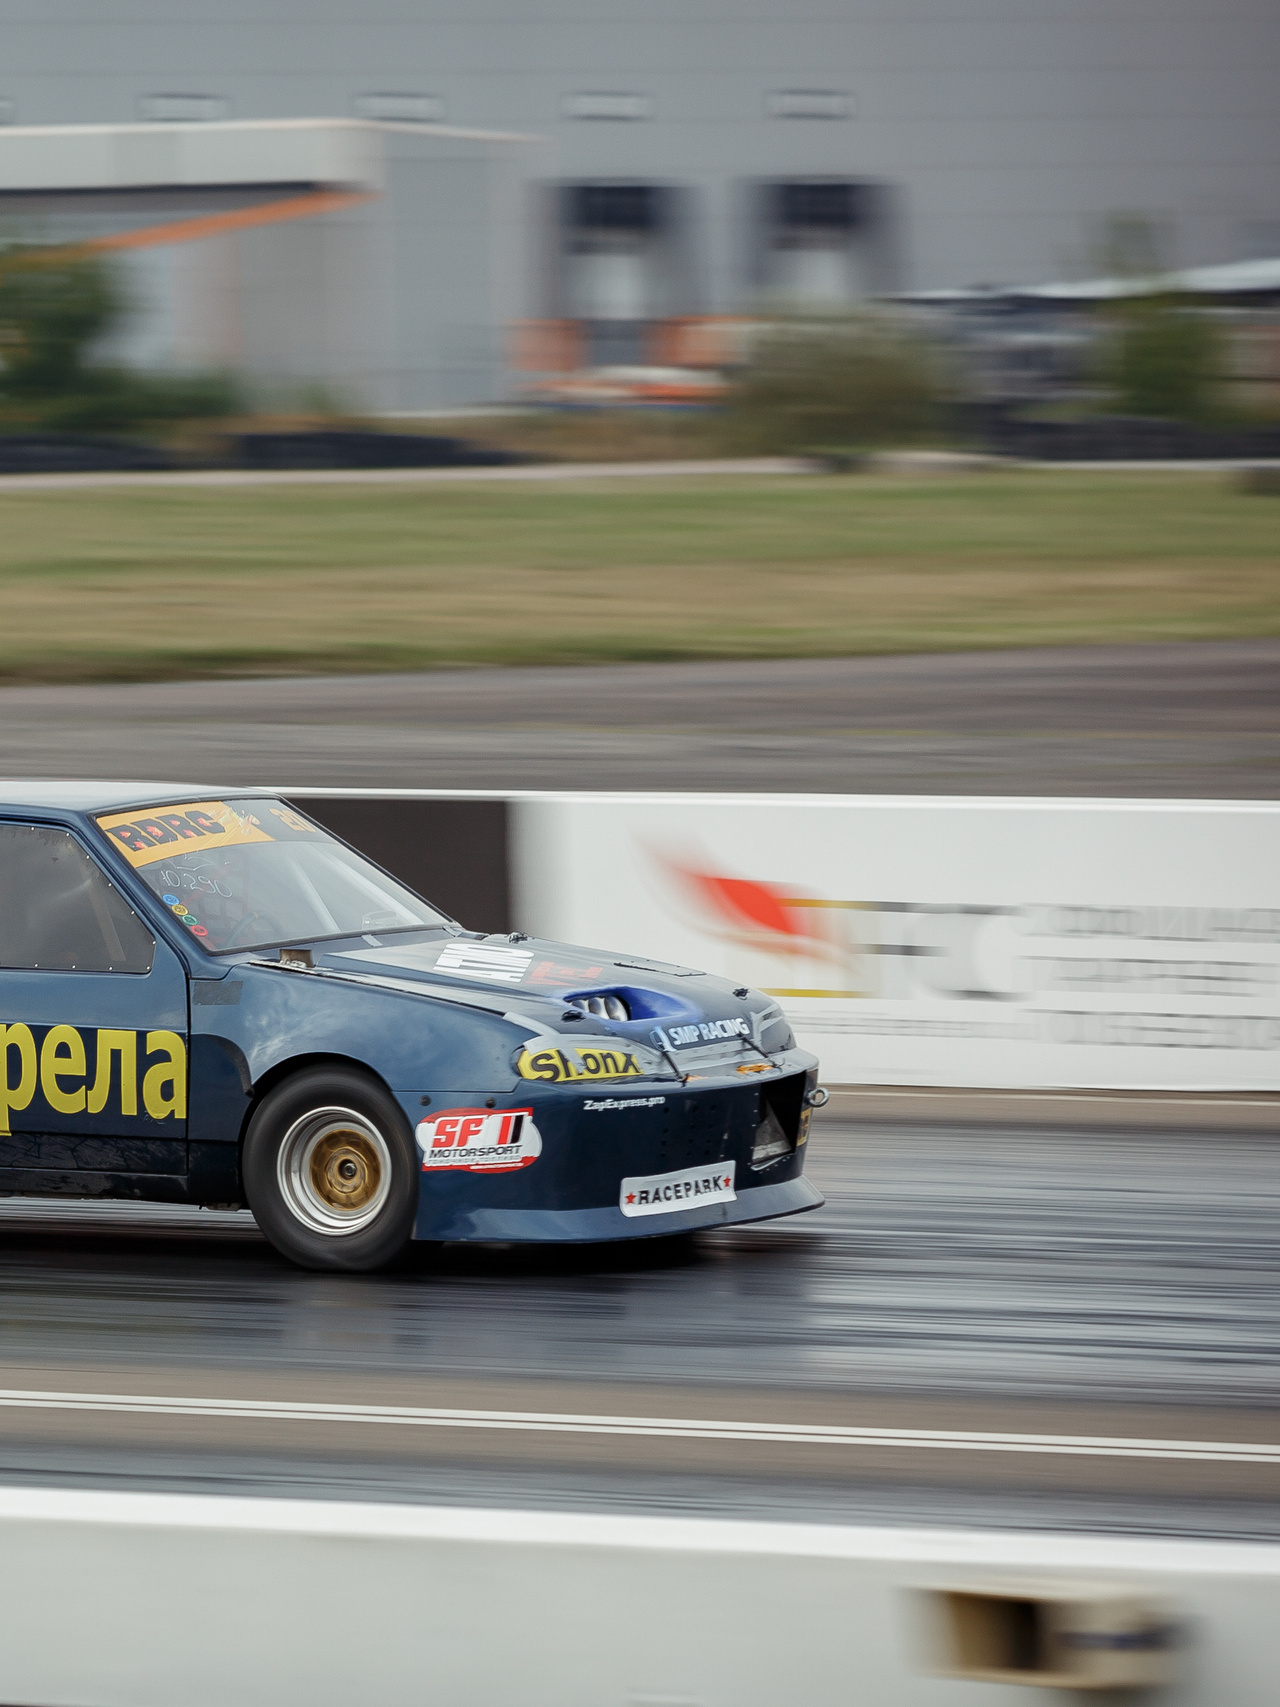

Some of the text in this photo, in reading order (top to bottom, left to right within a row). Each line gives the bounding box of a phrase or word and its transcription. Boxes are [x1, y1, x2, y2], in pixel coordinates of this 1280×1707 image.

[104, 810, 226, 852] RDRC
[668, 1017, 751, 1046] SMP RACING
[428, 1144, 523, 1159] MOTORSPORT
[638, 1175, 723, 1205] RACEPARK
